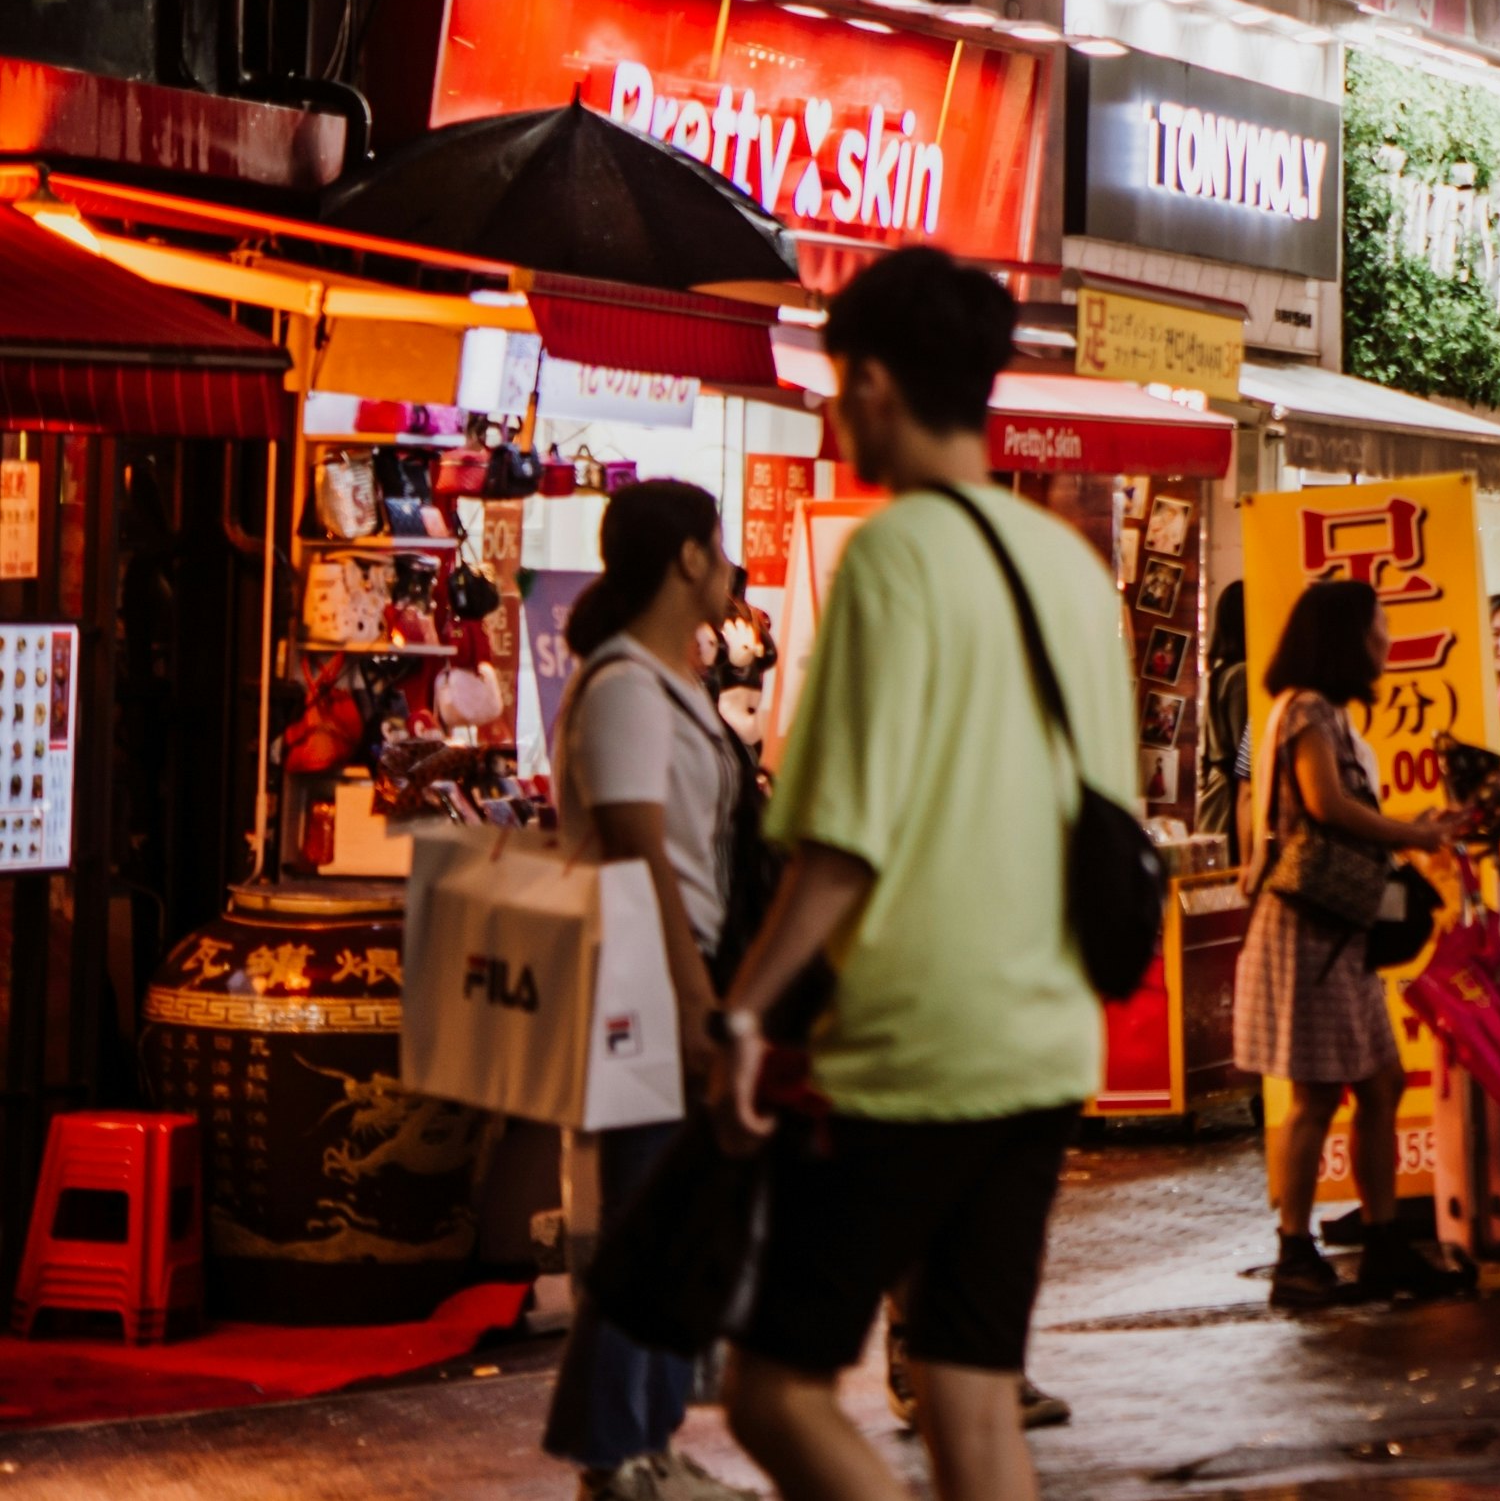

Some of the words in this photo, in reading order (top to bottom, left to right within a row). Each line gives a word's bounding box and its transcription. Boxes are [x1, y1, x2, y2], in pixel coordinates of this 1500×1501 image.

[831, 103, 943, 234] skin
[1150, 103, 1327, 221] TONYMOLY
[1003, 424, 1046, 462] Pretty
[464, 955, 540, 1017] FILA
